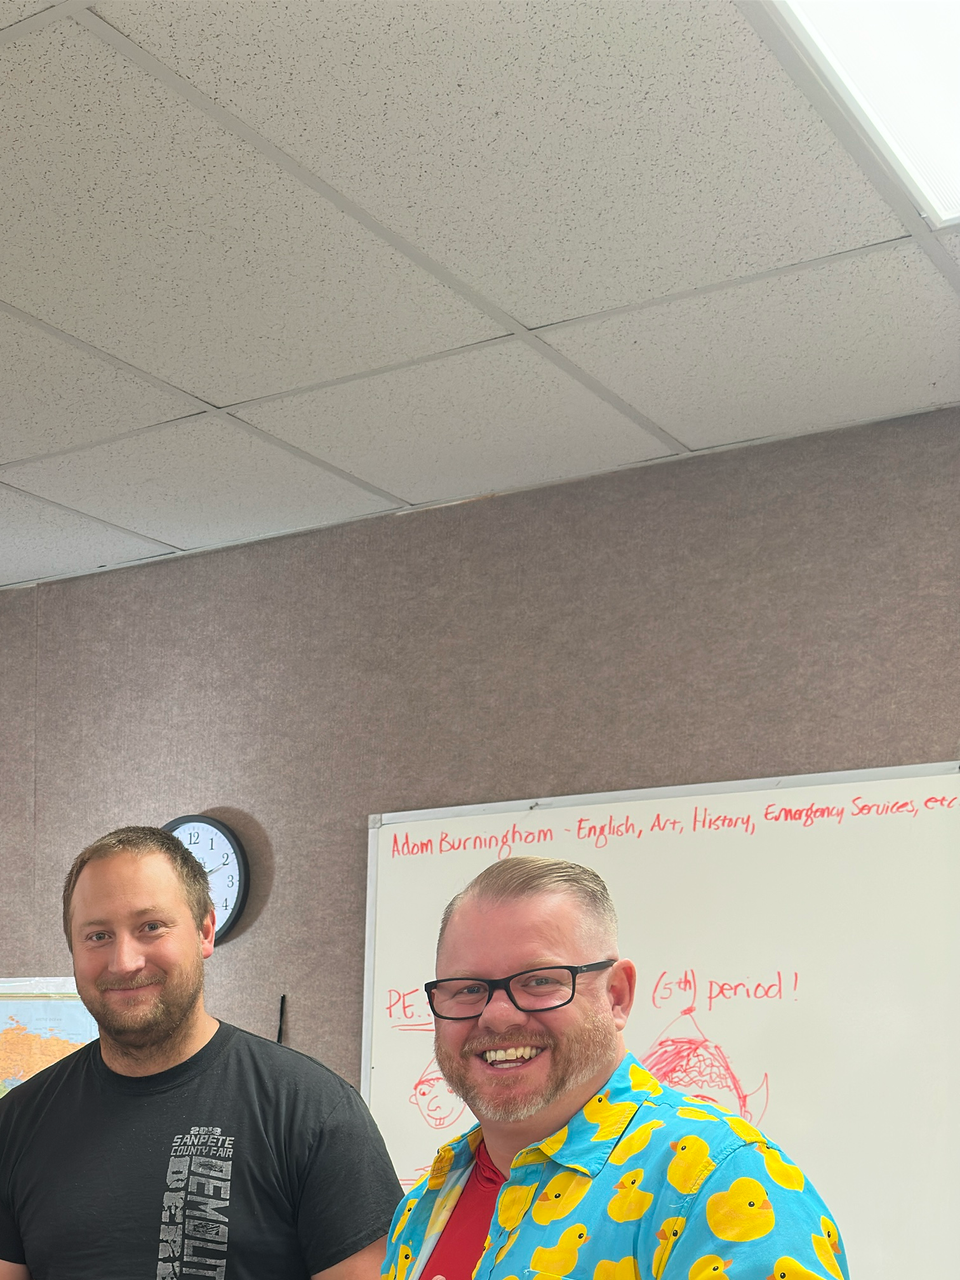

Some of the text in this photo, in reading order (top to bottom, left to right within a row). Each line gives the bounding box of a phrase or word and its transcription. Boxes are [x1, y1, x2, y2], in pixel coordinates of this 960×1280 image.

[576, 814, 643, 849] English,
[692, 806, 756, 836] History,
[763, 802, 845, 828] Emergency
[851, 796, 920, 818] Services,
[188, 831, 200, 845] 12
[209, 838, 215, 851] 1
[222, 852, 230, 866] 2
[227, 874, 235, 888] 3
[222, 897, 229, 911] 4
[172, 1135, 235, 1148] SANPETE
[170, 1146, 234, 1158] COUNTY FAIR
